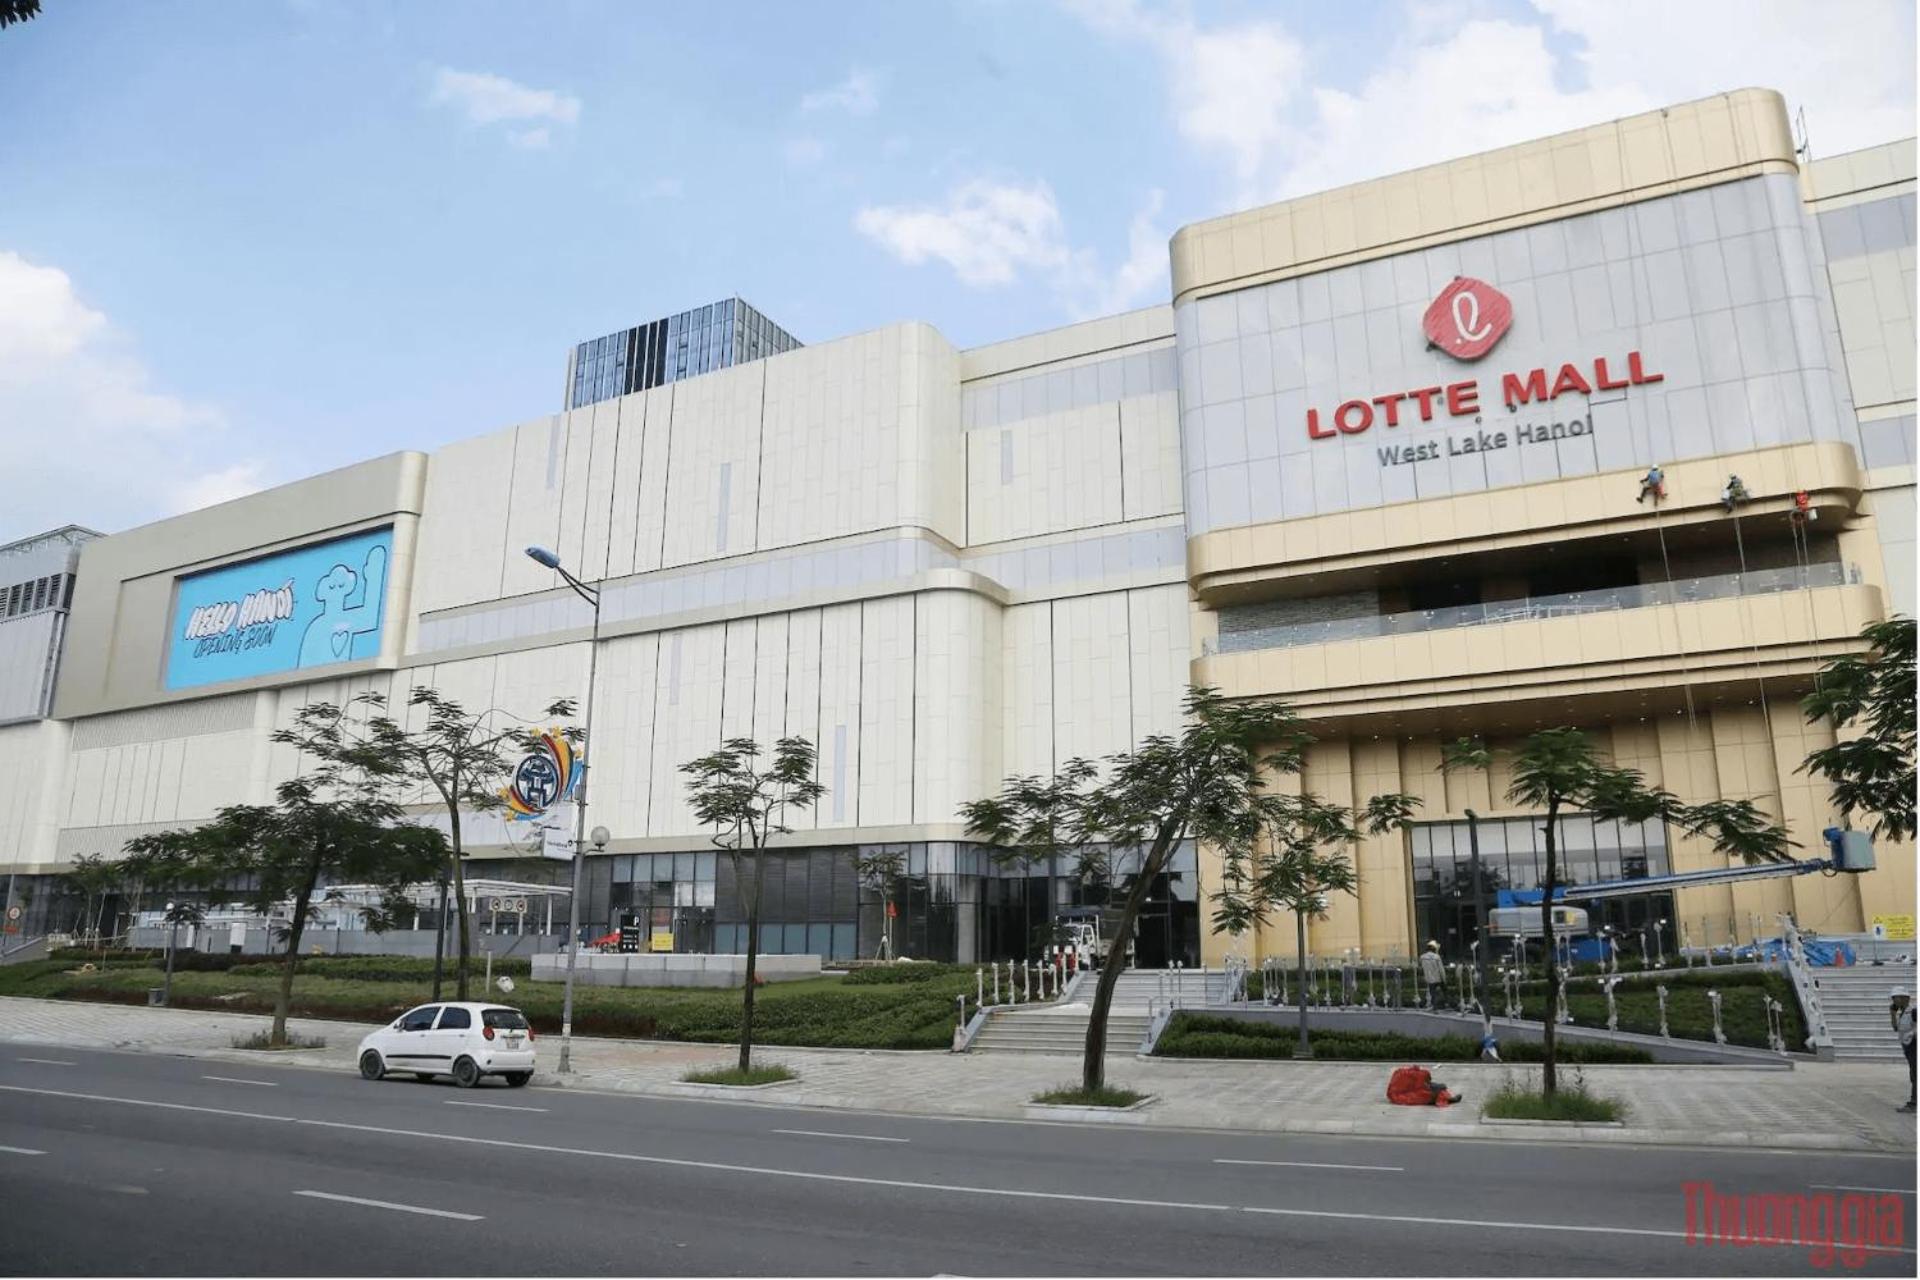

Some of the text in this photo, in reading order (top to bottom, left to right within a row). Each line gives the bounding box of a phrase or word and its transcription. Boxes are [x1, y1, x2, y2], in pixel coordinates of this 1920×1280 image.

[1306, 351, 1664, 440] LOTTE MALL
[1377, 440, 1440, 467] West
[1448, 430, 1508, 457] Lake
[244, 624, 279, 651] SOON
